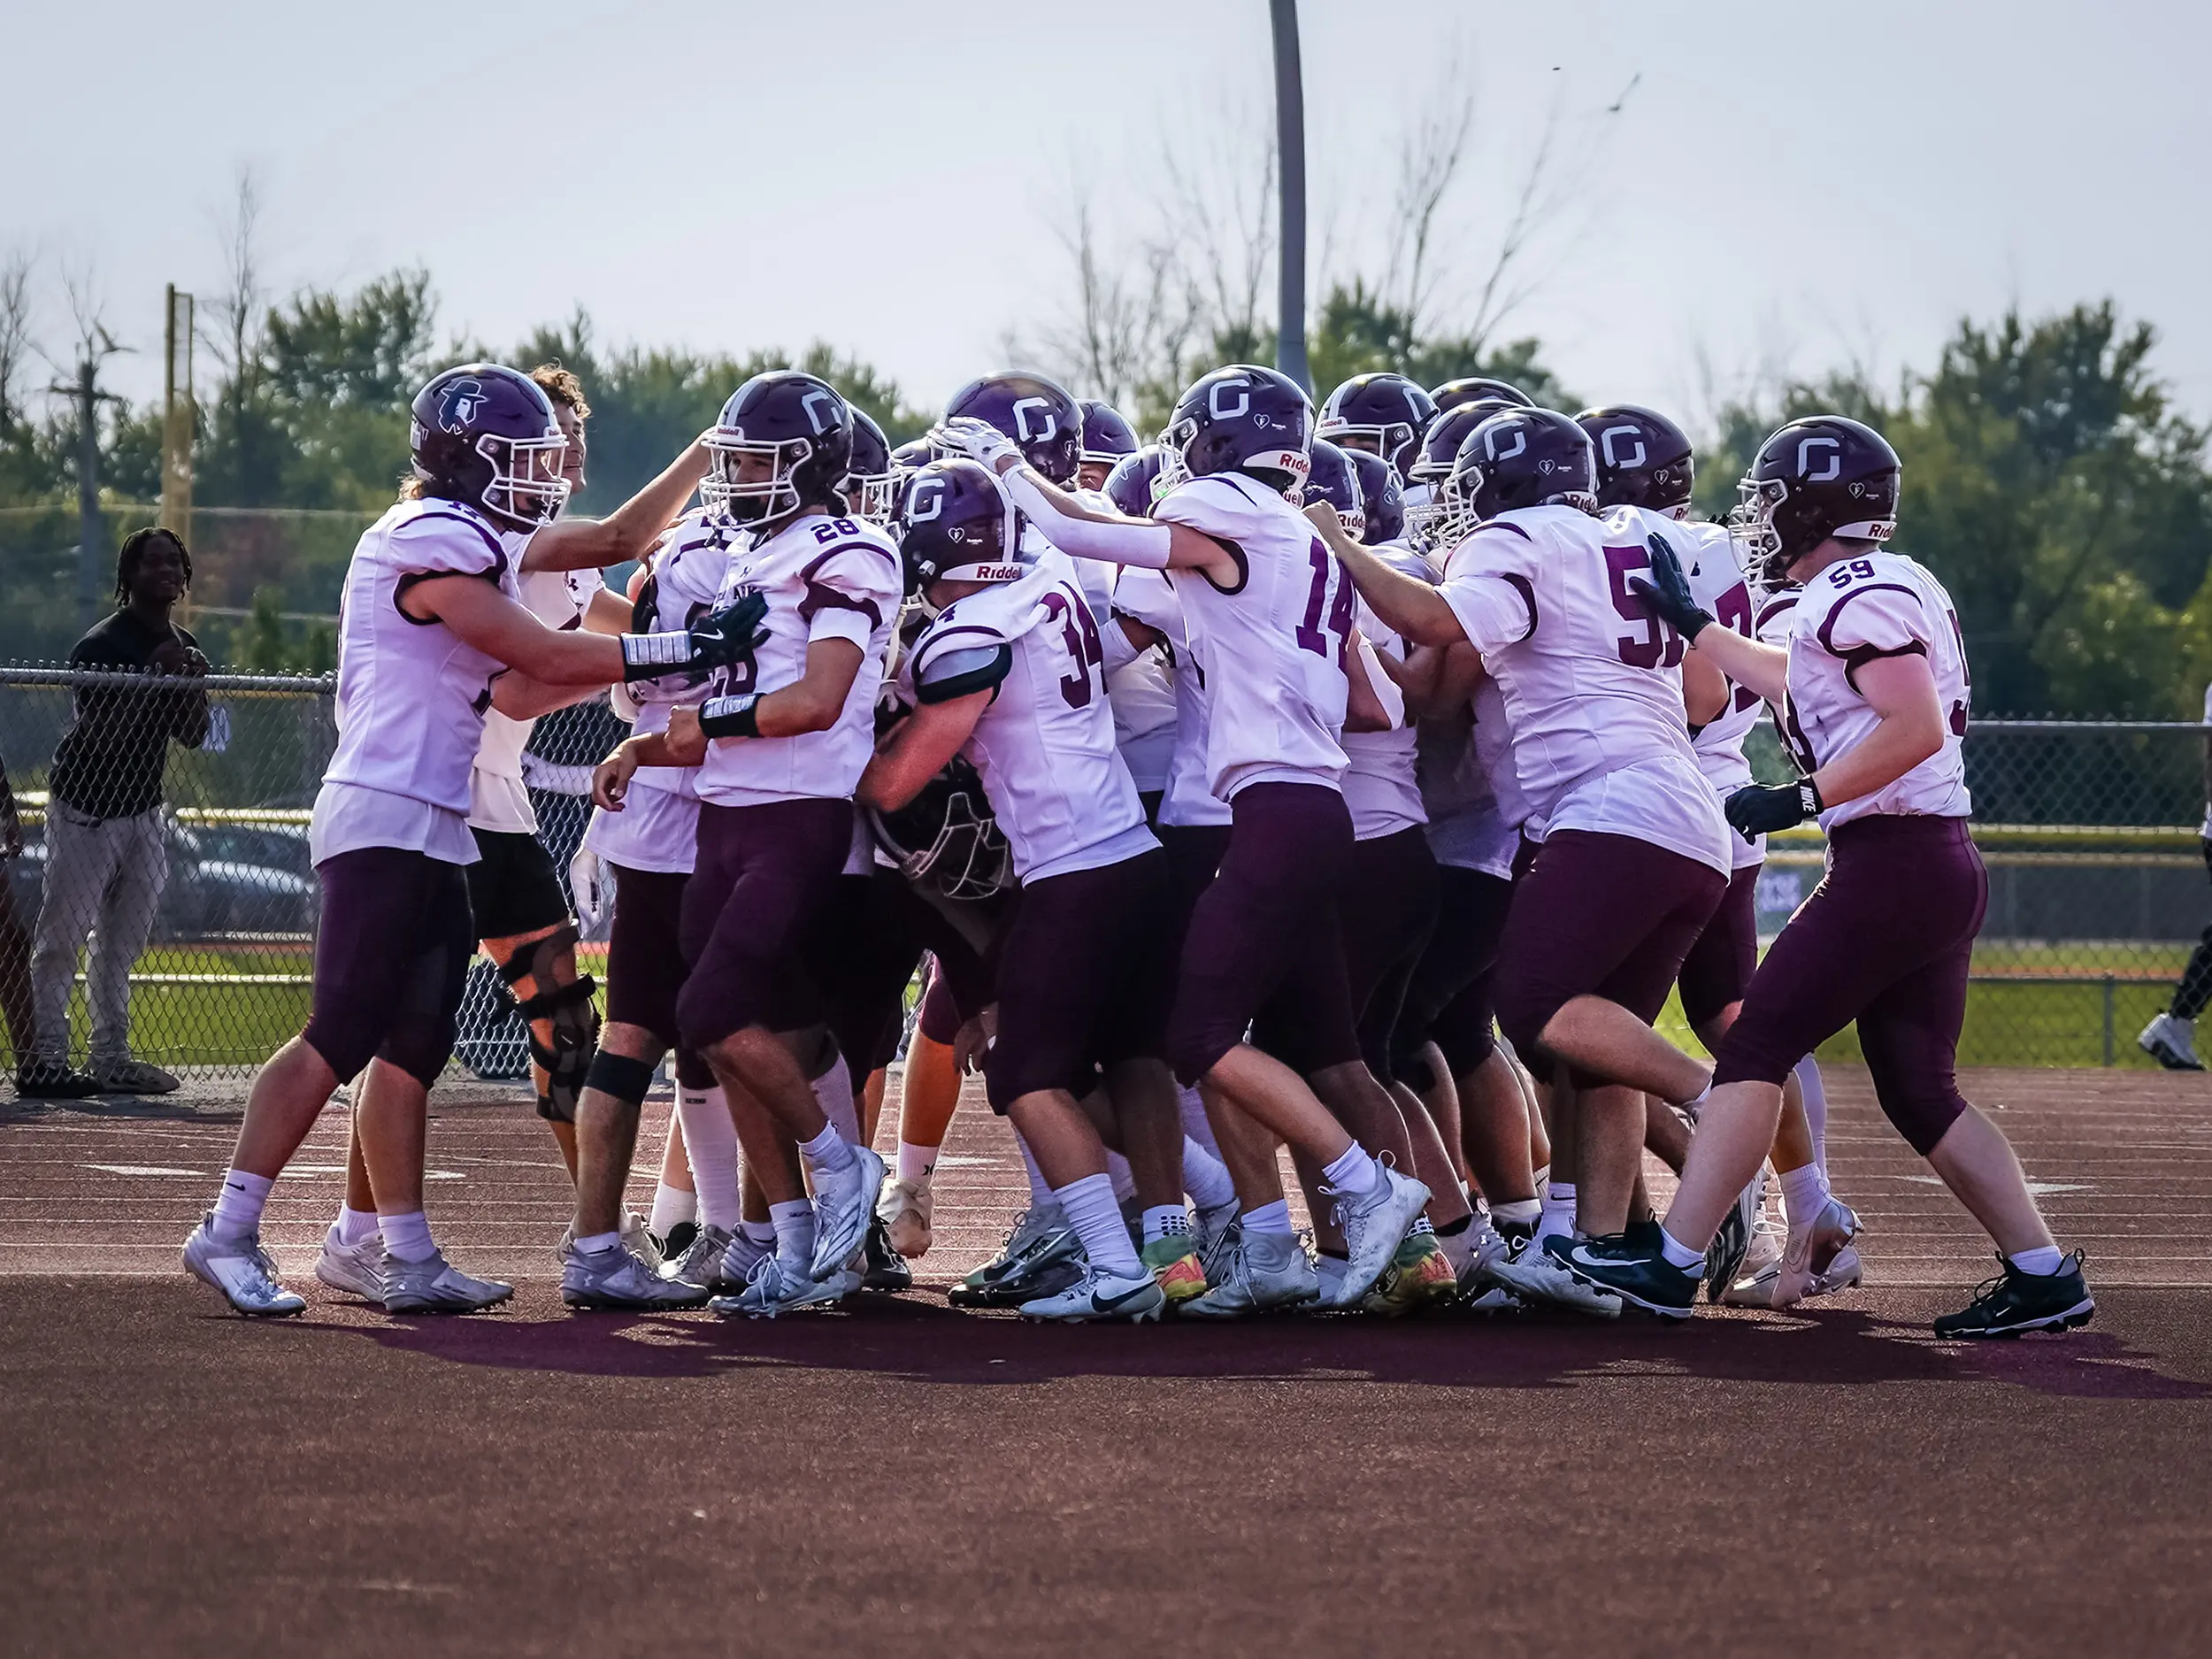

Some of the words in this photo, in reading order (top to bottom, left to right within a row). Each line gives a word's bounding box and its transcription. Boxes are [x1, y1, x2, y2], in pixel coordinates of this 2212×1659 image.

[1012, 396, 1056, 442] G
[1210, 379, 1249, 420] G
[1484, 419, 1526, 462] G
[1601, 425, 1647, 468] G
[1798, 437, 1840, 481] G
[908, 478, 946, 523] G
[810, 518, 860, 545] 28
[1828, 559, 1876, 589] 59
[1295, 535, 1354, 675] 14
[1040, 580, 1110, 710] 34
[1800, 785, 1816, 812] NIKE
